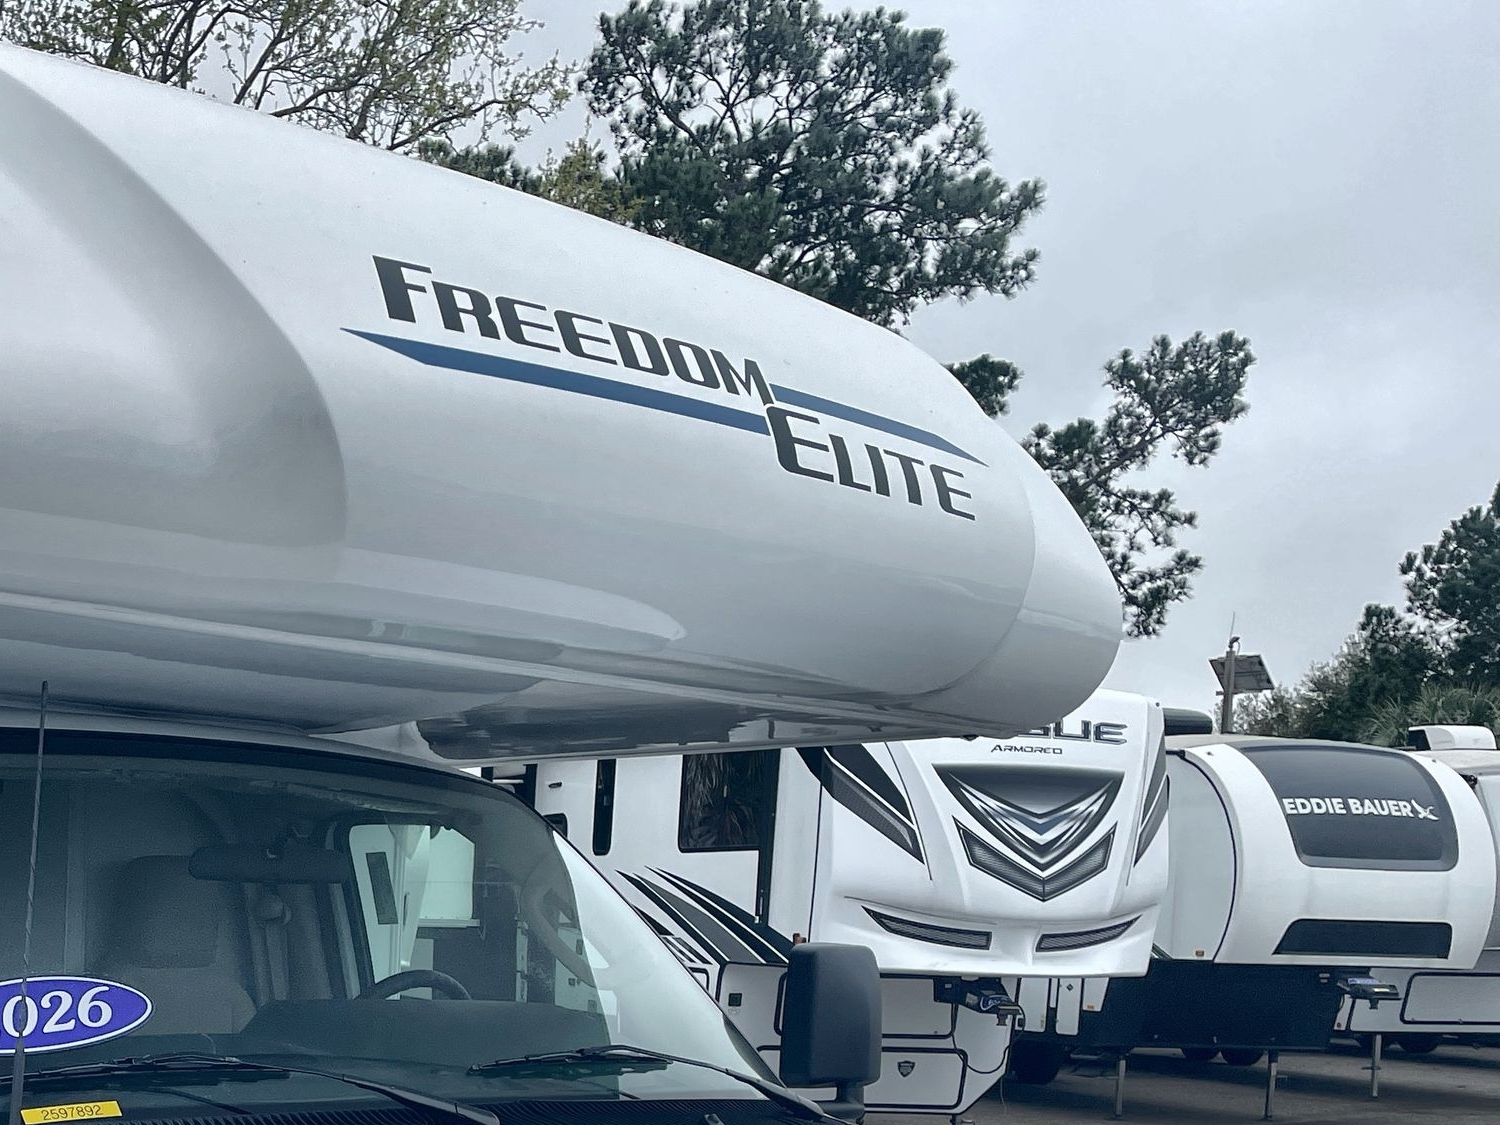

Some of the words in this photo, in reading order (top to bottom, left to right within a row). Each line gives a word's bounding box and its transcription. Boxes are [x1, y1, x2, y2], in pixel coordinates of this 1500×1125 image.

[372, 255, 774, 405] FREEDOM
[767, 404, 976, 521] ELITE
[1282, 798, 1347, 815] EDDIE
[1348, 799, 1414, 817] BAUER
[40, 1104, 104, 1121] 2597892
